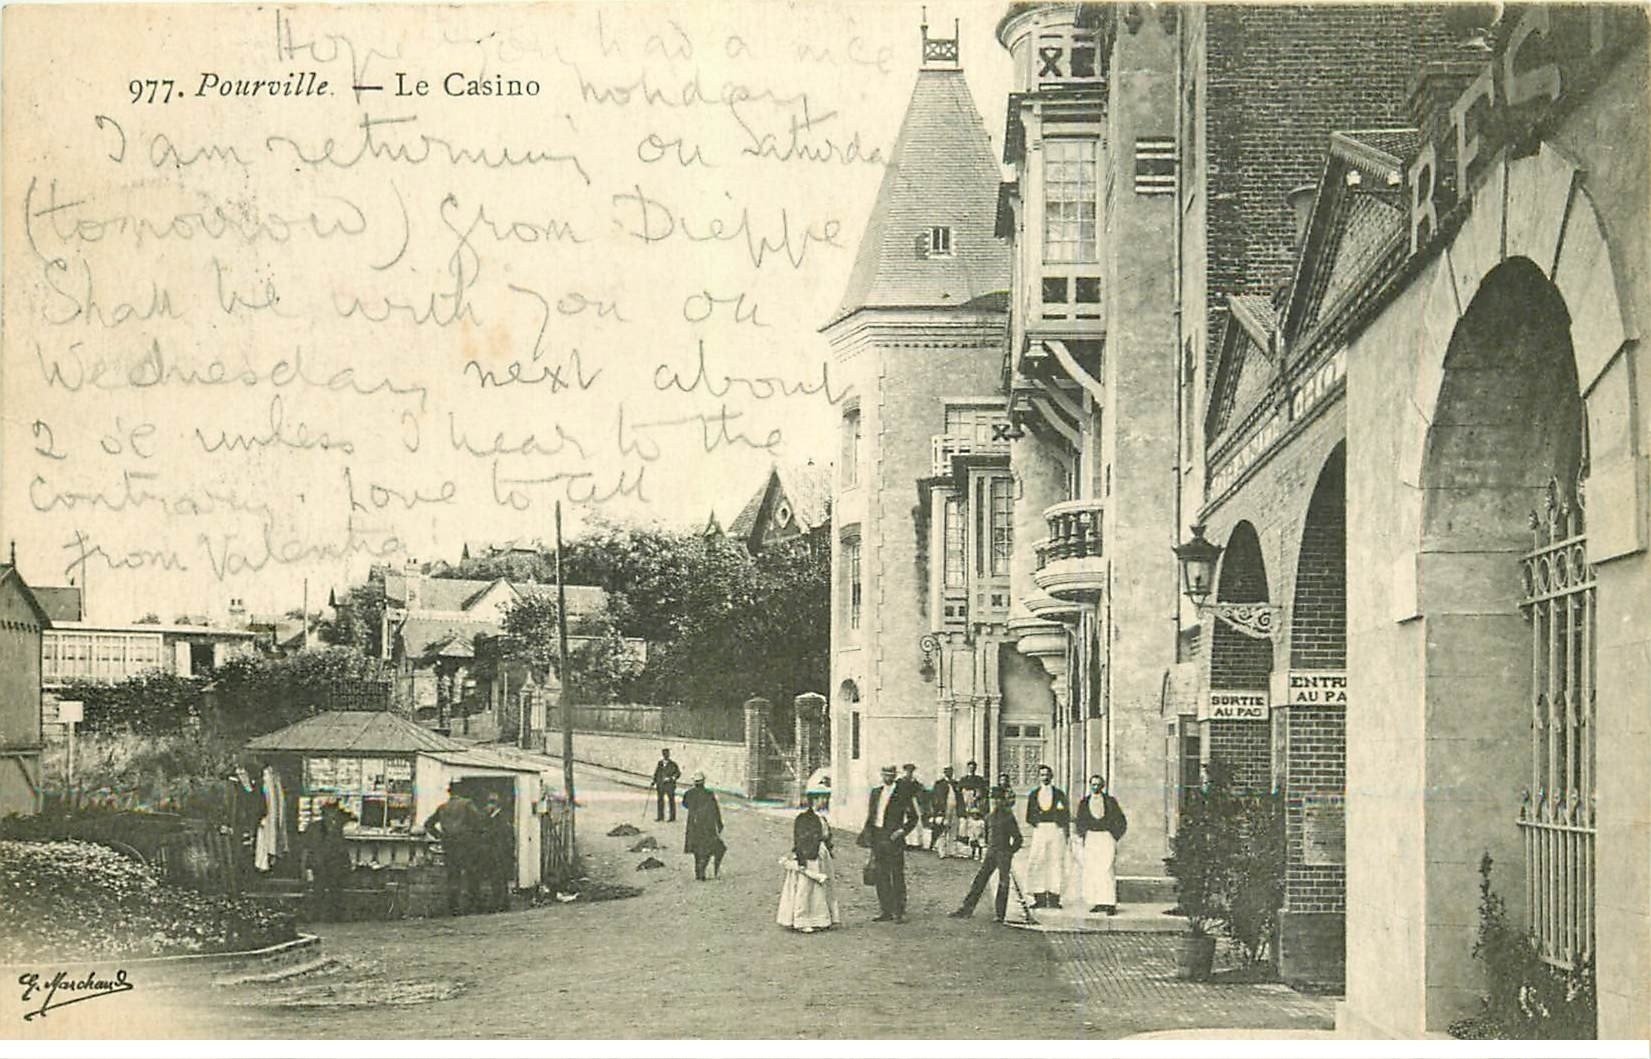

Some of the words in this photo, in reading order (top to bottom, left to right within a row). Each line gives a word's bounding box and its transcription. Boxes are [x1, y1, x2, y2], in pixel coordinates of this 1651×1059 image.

[150, 133, 249, 168] am
[612, 185, 846, 270] Dieppe
[508, 284, 628, 361] you
[464, 349, 602, 393] next
[653, 339, 856, 405] about
[32, 419, 67, 459] 2
[196, 393, 355, 455] unless
[449, 411, 588, 459] hear
[1211, 696, 1265, 706] SORTIE
[1213, 708, 1233, 718] AU
[1296, 691, 1318, 702] AU
